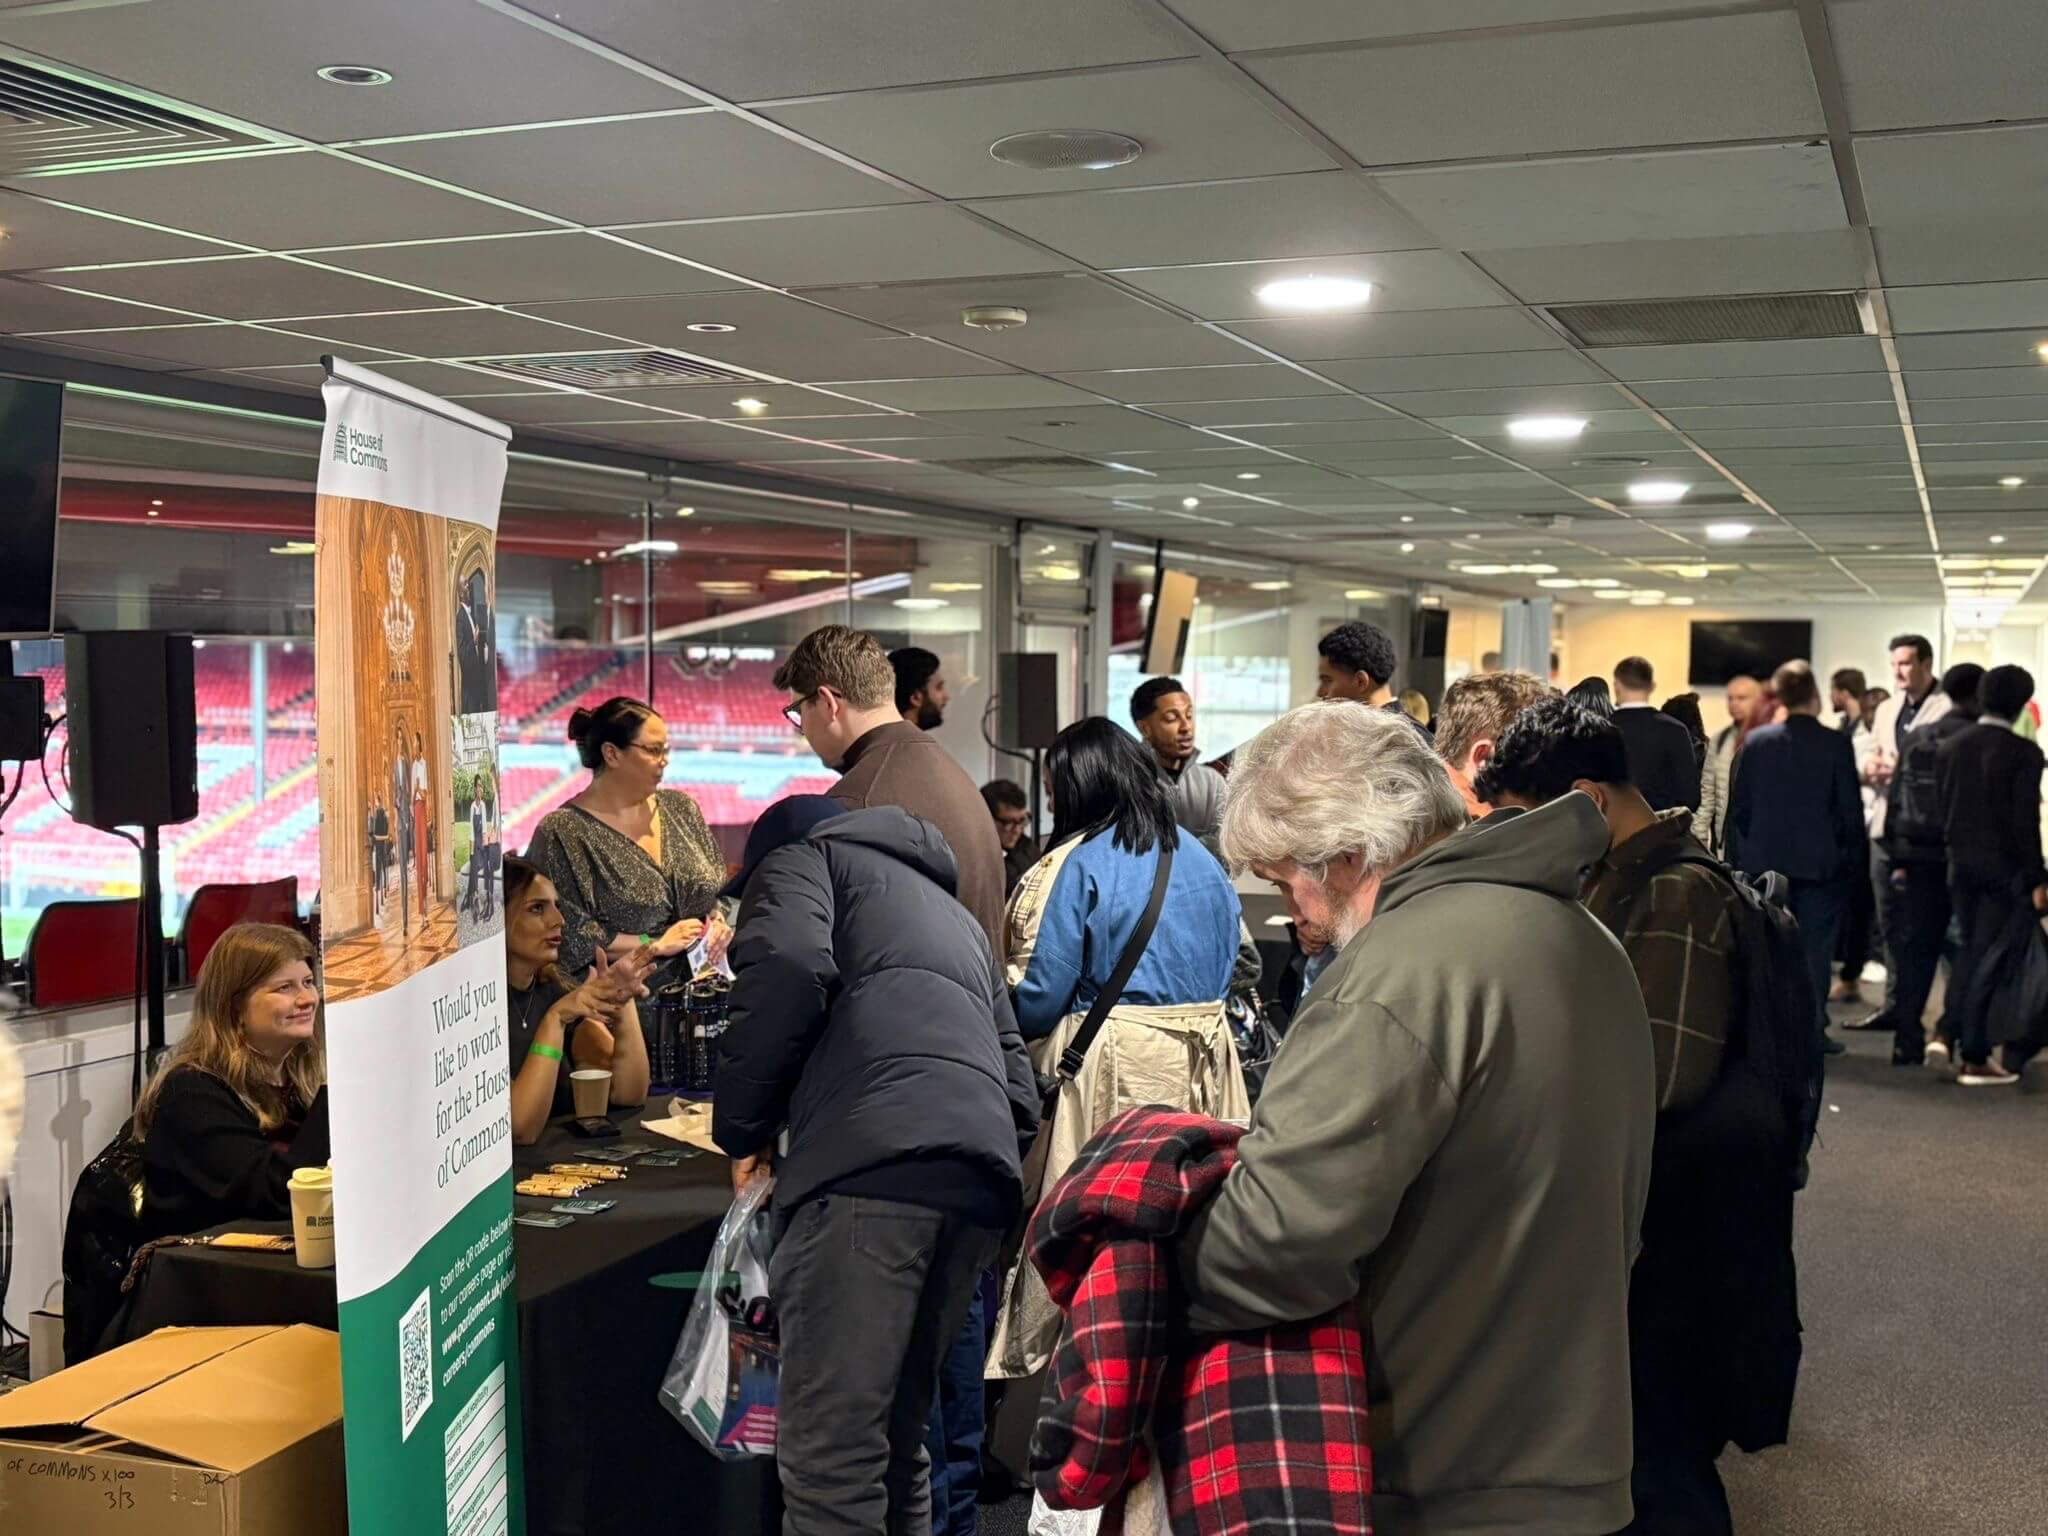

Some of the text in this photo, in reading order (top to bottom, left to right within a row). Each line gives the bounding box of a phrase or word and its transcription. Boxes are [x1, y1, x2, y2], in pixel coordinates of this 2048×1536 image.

[350, 428, 378, 450] House
[350, 447, 388, 472] Commons
[432, 980, 496, 1034] Would you
[434, 1015, 502, 1088] like to work
[436, 1100, 453, 1139] for
[454, 1085, 472, 1124] the
[437, 1145, 450, 1189] of
[454, 1255, 465, 1278] the
[465, 1245, 474, 1269] QR
[474, 1231, 490, 1257] code
[490, 1219, 508, 1243] below
[440, 1307, 448, 1325] to
[448, 1295, 459, 1317] our
[458, 1272, 480, 1305] careers
[480, 1257, 497, 1288] page
[497, 1250, 504, 1267] or
[443, 1316, 496, 1387] careers/commons
